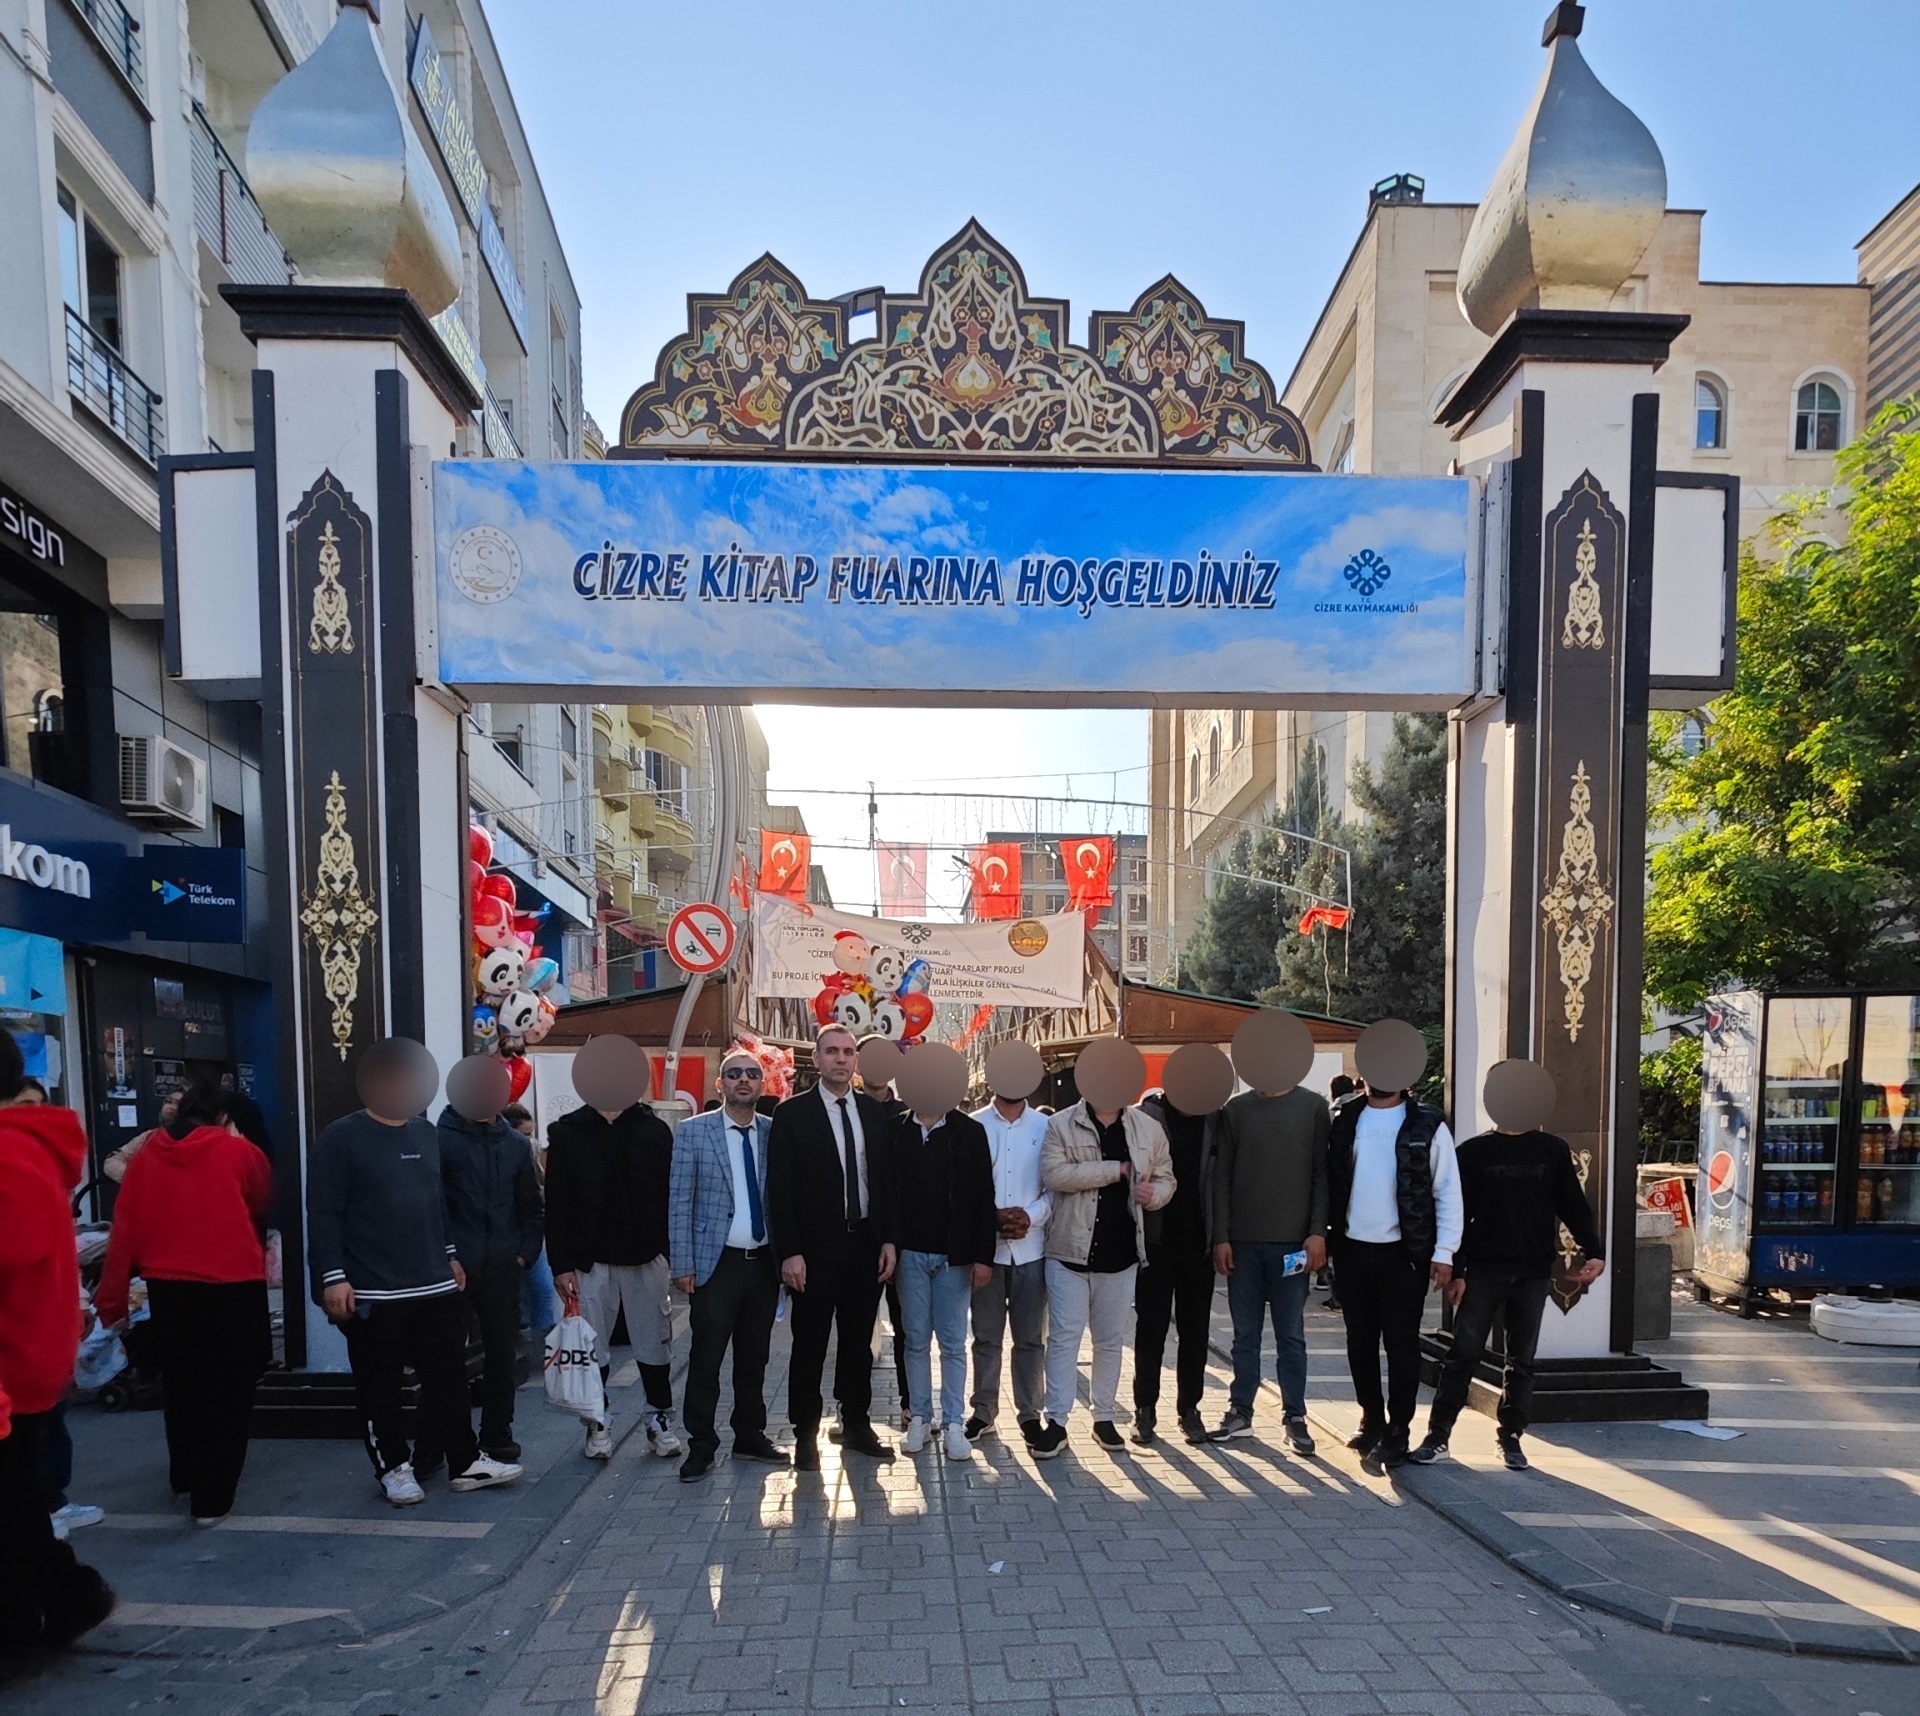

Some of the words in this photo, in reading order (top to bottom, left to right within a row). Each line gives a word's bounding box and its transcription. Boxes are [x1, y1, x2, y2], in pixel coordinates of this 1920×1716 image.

[448, 99, 486, 194] AVUKAT
[572, 540, 688, 600] CİZRE
[699, 542, 818, 602] KİTAP
[827, 555, 1004, 605] FUARINA
[1016, 549, 1280, 618] HOŞGELDİNİZ
[1314, 602, 1342, 613] CİZRE
[1344, 603, 1419, 613] KAYMAKAMLIĞI
[0, 824, 91, 899] kom
[188, 883, 212, 894] Türk
[188, 894, 236, 906] Telekom
[993, 964, 1025, 974] PROJESİ
[784, 972, 809, 980] PROJE
[931, 978, 949, 986] MLA
[949, 977, 984, 988] İLİŞKİLER
[929, 989, 985, 999] LENMEKTEDİR.
[1724, 1010, 1752, 1034] pepsi
[1709, 1055, 1749, 1078] PEPSI
[1709, 1214, 1733, 1231] pepsi
